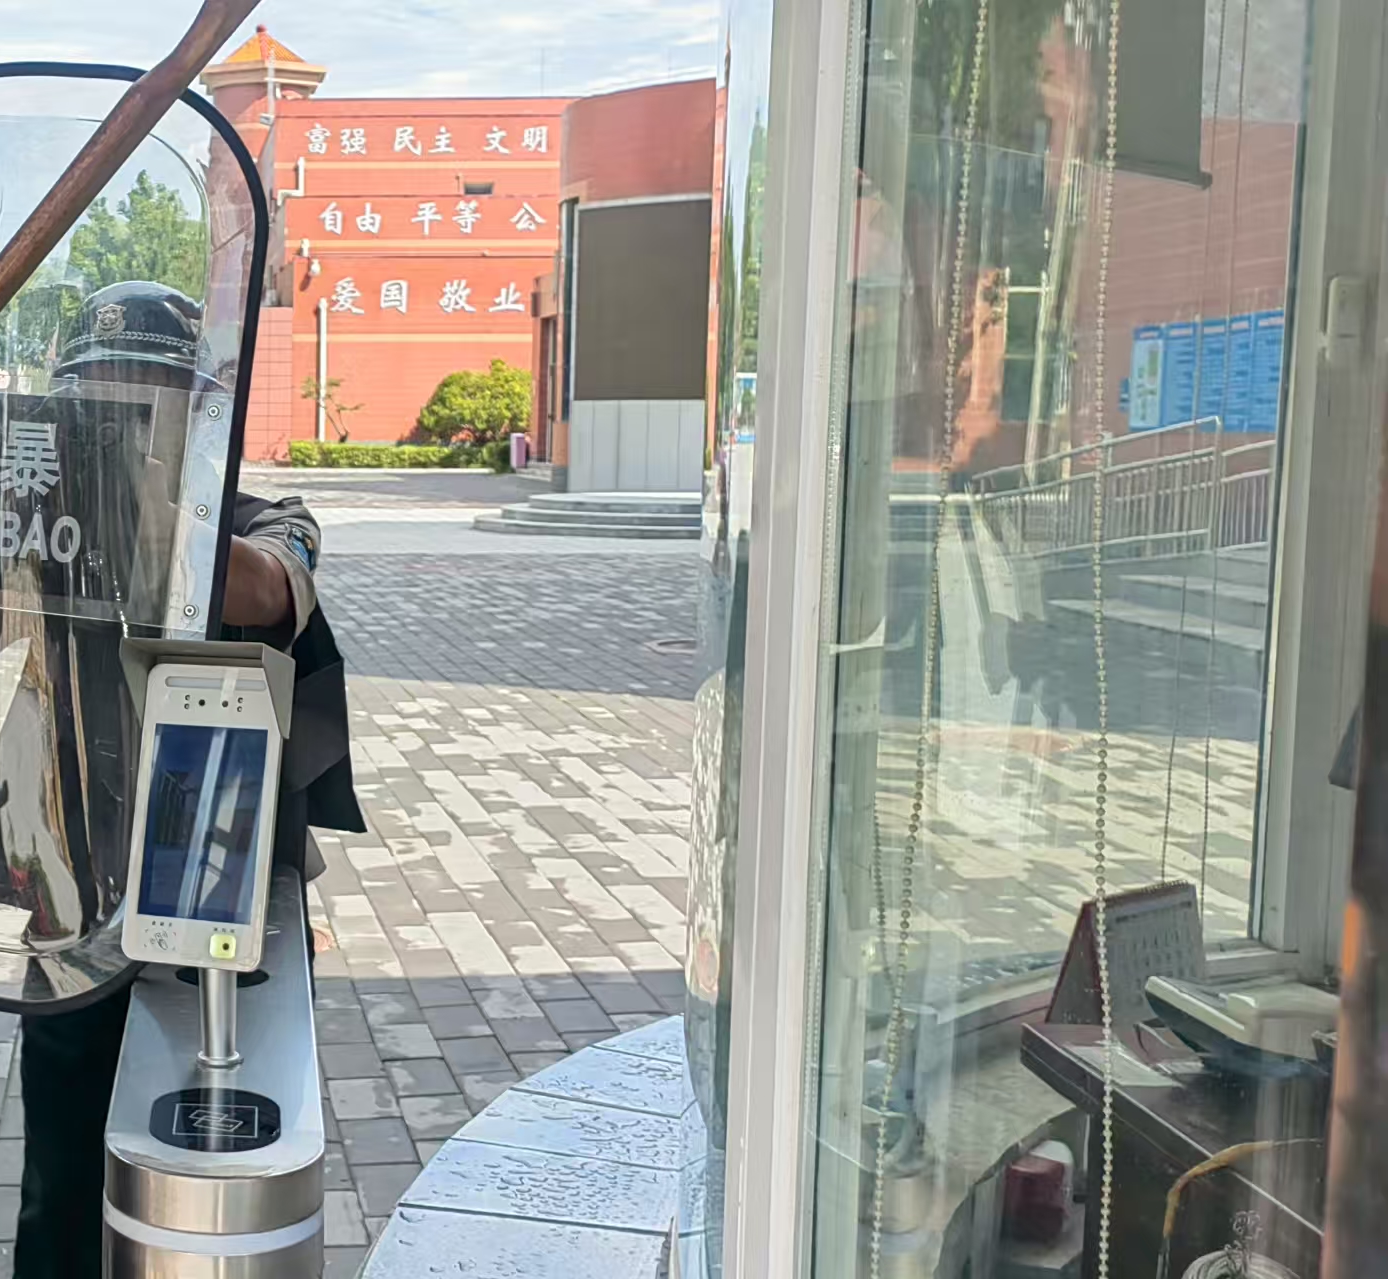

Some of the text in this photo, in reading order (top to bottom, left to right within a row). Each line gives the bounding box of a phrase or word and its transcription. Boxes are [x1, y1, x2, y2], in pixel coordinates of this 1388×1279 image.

[305, 123, 548, 156] 富强 民主 文明
[320, 200, 547, 236] 自由 平等 公
[331, 277, 526, 314] 爱国 敬业
